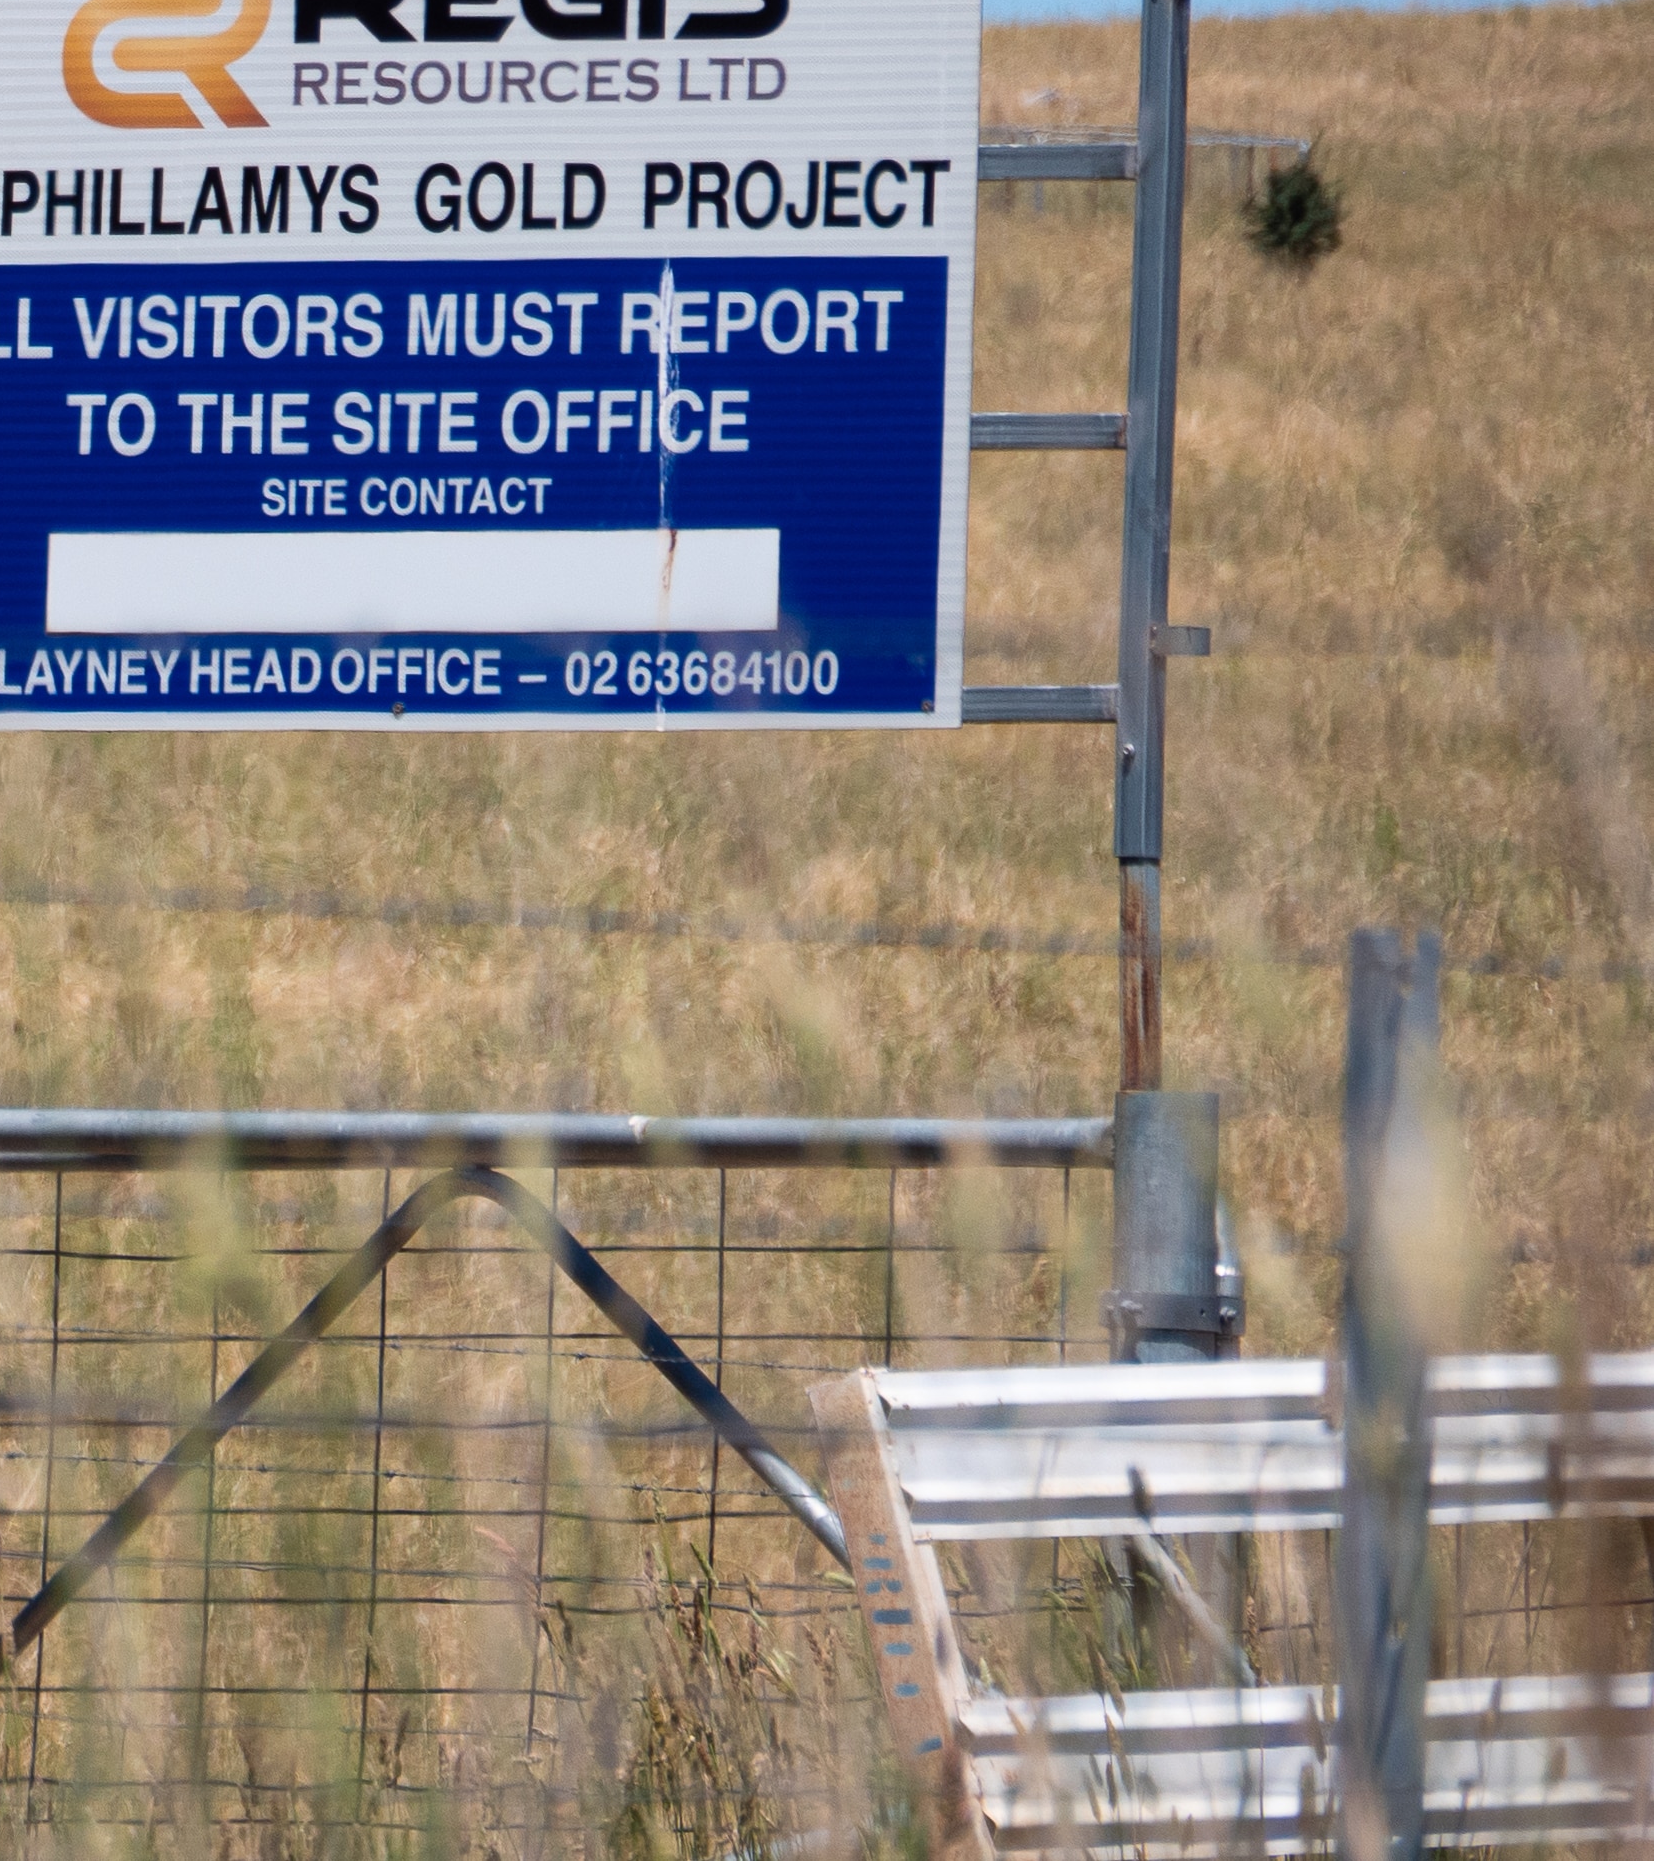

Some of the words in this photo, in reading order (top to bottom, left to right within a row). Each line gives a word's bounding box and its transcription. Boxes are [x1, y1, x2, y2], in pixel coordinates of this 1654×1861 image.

[293, 59, 659, 105] RESOURCES
[679, 58, 786, 101] LTD
[415, 162, 605, 233] GOLD
[644, 160, 950, 229] PROJECT
[74, 294, 382, 358] VISITORS
[408, 292, 598, 356] MUST
[621, 290, 903, 355] REPORT
[67, 393, 155, 456] TO
[178, 394, 309, 454] THE
[333, 392, 477, 454] SITE
[502, 390, 748, 454] OFFICE
[262, 479, 346, 516] SITE
[361, 477, 551, 515] CONTACT
[190, 649, 321, 693] HEAD
[331, 648, 500, 694] OFFICE
